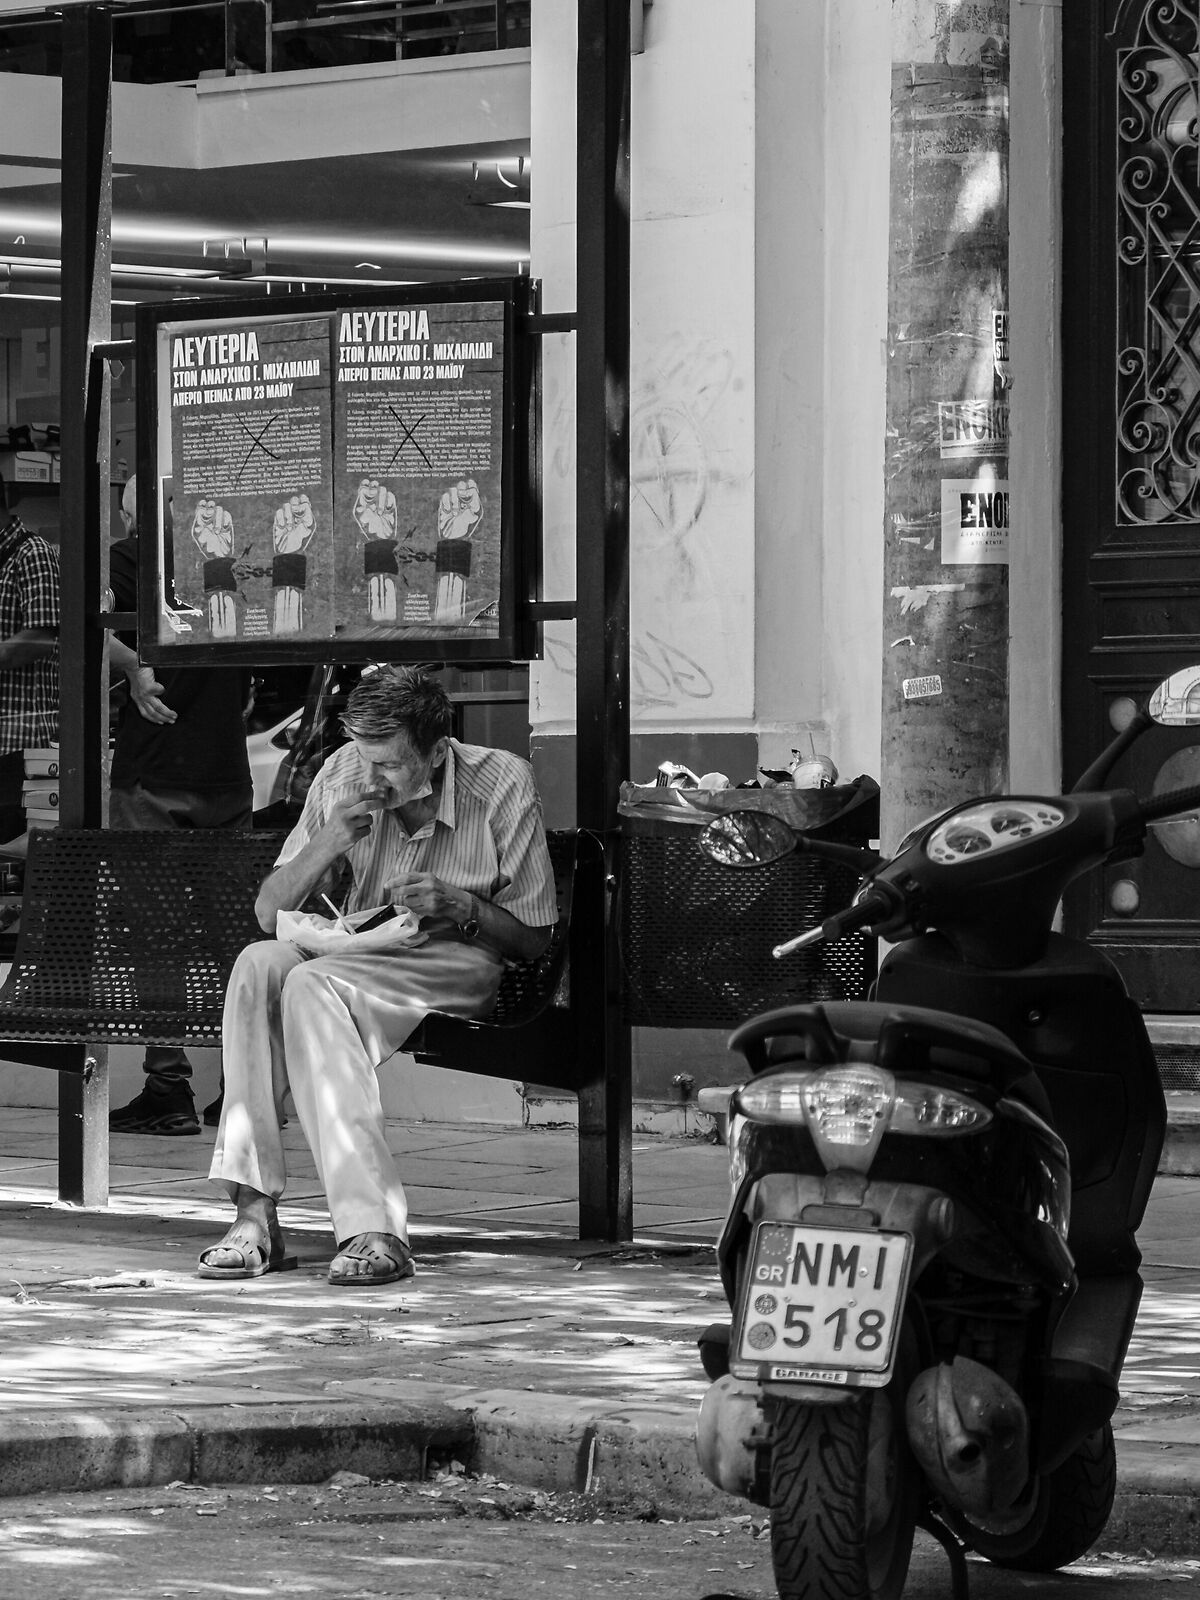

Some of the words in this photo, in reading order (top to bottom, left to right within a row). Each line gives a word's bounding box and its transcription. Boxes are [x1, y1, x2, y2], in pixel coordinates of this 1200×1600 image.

[340, 310, 430, 343] ΛΕΥΤΕΡΙΑ
[173, 332, 260, 368] ΛΕΥΤΕΡΙΑ
[340, 346, 366, 364] ΣΤΟΝ
[368, 344, 420, 362] ΑΝΑΡΧΙΚΟ
[422, 344, 431, 361] Γ.
[433, 342, 493, 360] ΜΙΧΑΗΛΙΔΗ
[173, 370, 198, 388] ΣΤΟΝ
[200, 366, 251, 386] ΑΝΑΡΧΙΚΟ
[253, 366, 262, 382] Γ.
[263, 360, 320, 381] ΜΙΧΑΗΛΙΔΗ
[338, 366, 368, 382] ΑΠΕΡΓΟ
[370, 366, 401, 382] ΠΕΙΝΑΣ
[403, 366, 421, 380] ΑΠΟ
[423, 366, 434, 380] 23
[436, 364, 464, 380] ΜΑΪΟΥ
[173, 390, 202, 406] ΑΠΕΡΓΟ
[204, 387, 233, 404] ΠΕΙΝΑΣ
[235, 386, 253, 402] ΑΠΟ
[254, 385, 265, 400] 23
[266, 382, 294, 400] ΜΑΪΟΥ
[755, 1264, 784, 1282] GR
[791, 1242, 888, 1290] NMI
[783, 1304, 886, 1352] 518
[775, 1368, 845, 1383] GARAGE
